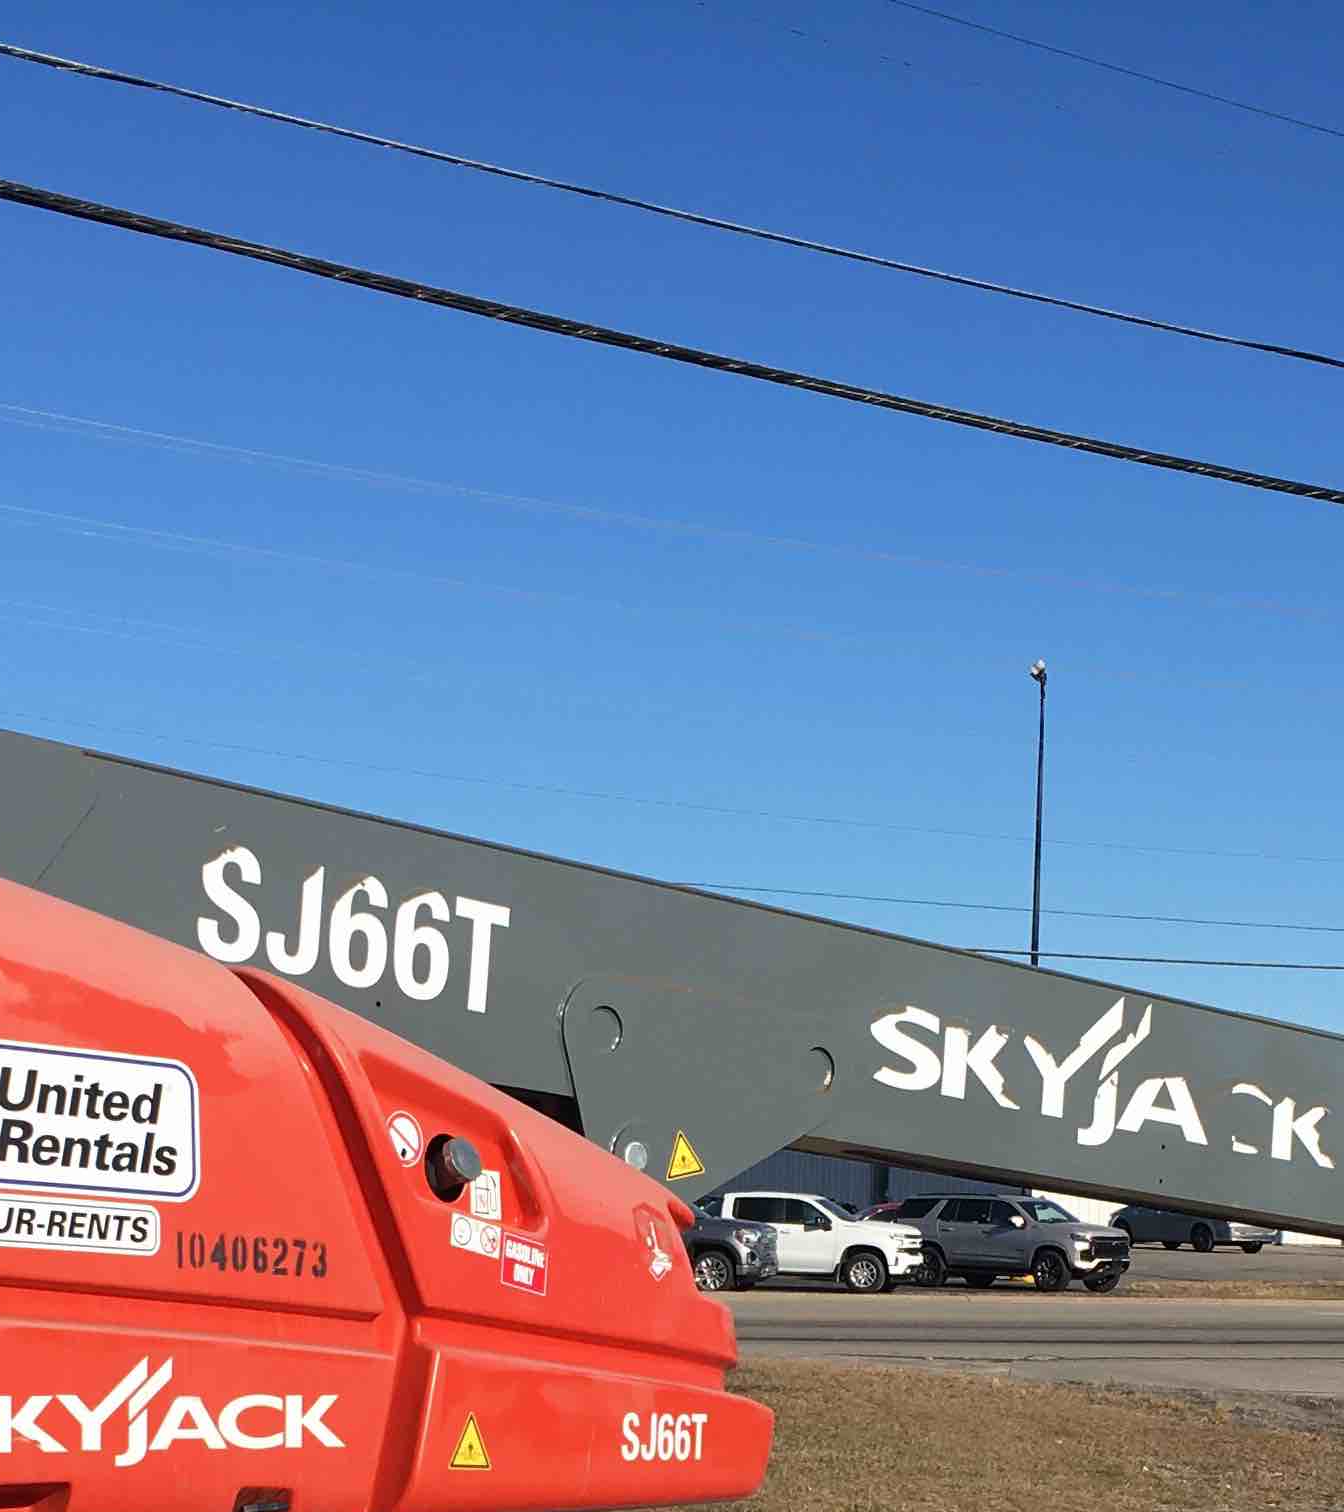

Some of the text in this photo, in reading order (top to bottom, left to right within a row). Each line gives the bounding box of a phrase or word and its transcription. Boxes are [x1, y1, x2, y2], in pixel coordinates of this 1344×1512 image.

[197, 845, 511, 1014] SJ66T
[176, 1231, 328, 1279] 10406273
[620, 1412, 708, 1461] SJ66T
